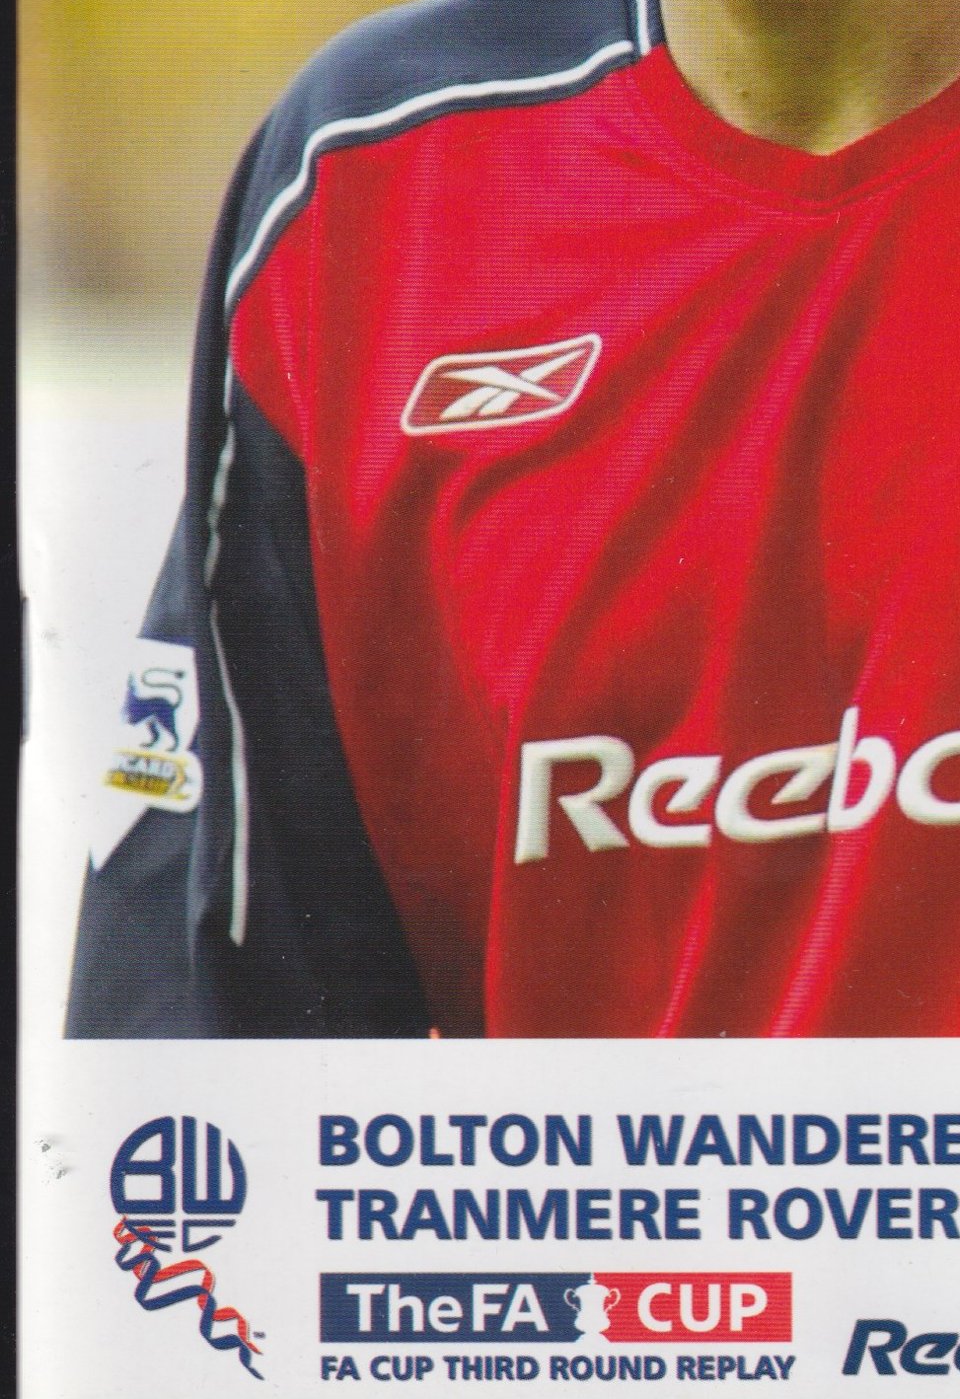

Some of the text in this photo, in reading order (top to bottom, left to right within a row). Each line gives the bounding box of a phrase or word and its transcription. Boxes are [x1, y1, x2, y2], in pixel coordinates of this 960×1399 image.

[319, 1112, 593, 1167] BOLTON
[315, 1188, 702, 1241] TRANMERE
[636, 1282, 768, 1333] CUP
[320, 1354, 797, 1381] FA CUP THIRD ROUND REPLAY
